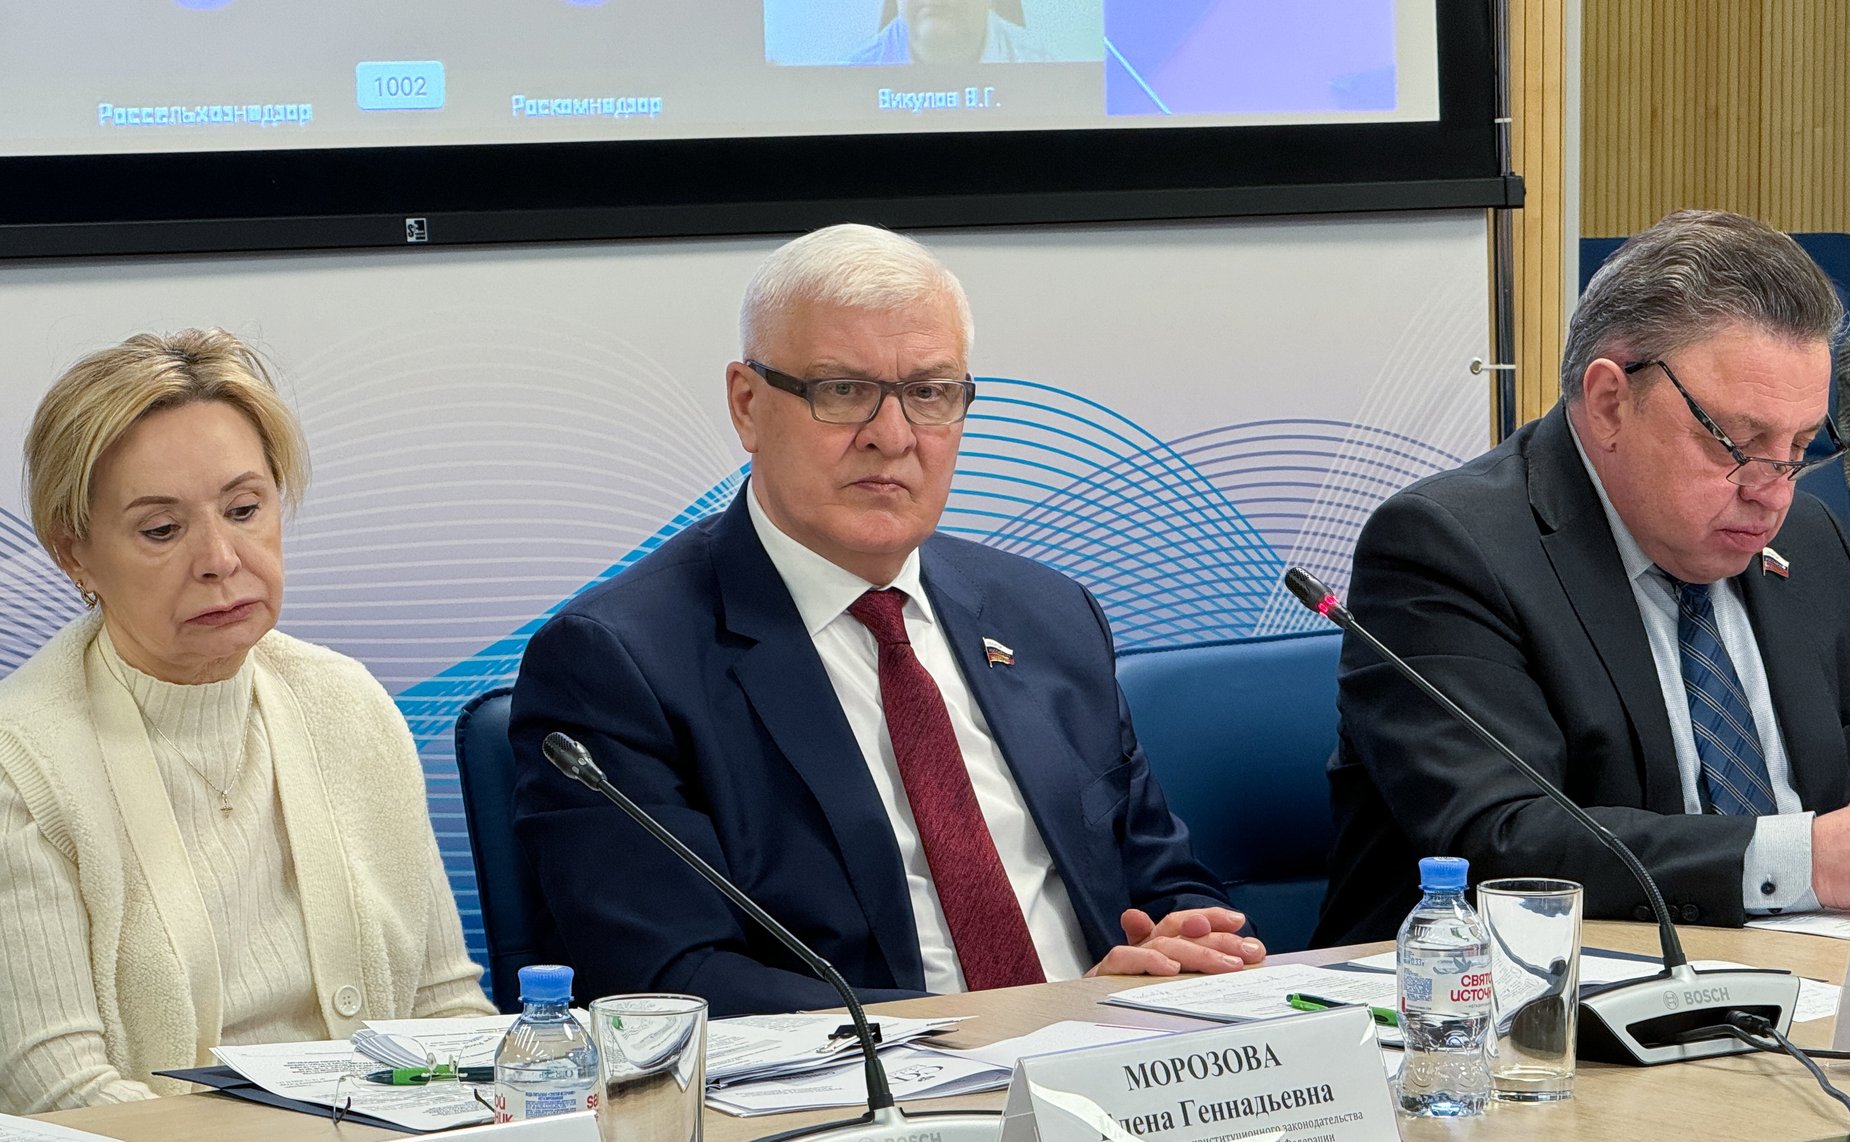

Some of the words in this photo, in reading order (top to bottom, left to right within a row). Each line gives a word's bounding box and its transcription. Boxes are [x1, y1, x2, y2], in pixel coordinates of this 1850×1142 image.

[374, 76, 428, 97] 1002
[511, 94, 664, 117] Роскомнадзор
[878, 87, 959, 114] Викулов
[964, 86, 1001, 107] В.Г.
[97, 102, 314, 128] Россельхознадзор
[1683, 987, 1730, 1005] BOSCH
[1121, 1042, 1283, 1091] МОРОЗОВА
[1100, 1110, 1176, 1142] лена
[1178, 1083, 1335, 1127] Геннадьевна
[1282, 1111, 1364, 1132] законодательства
